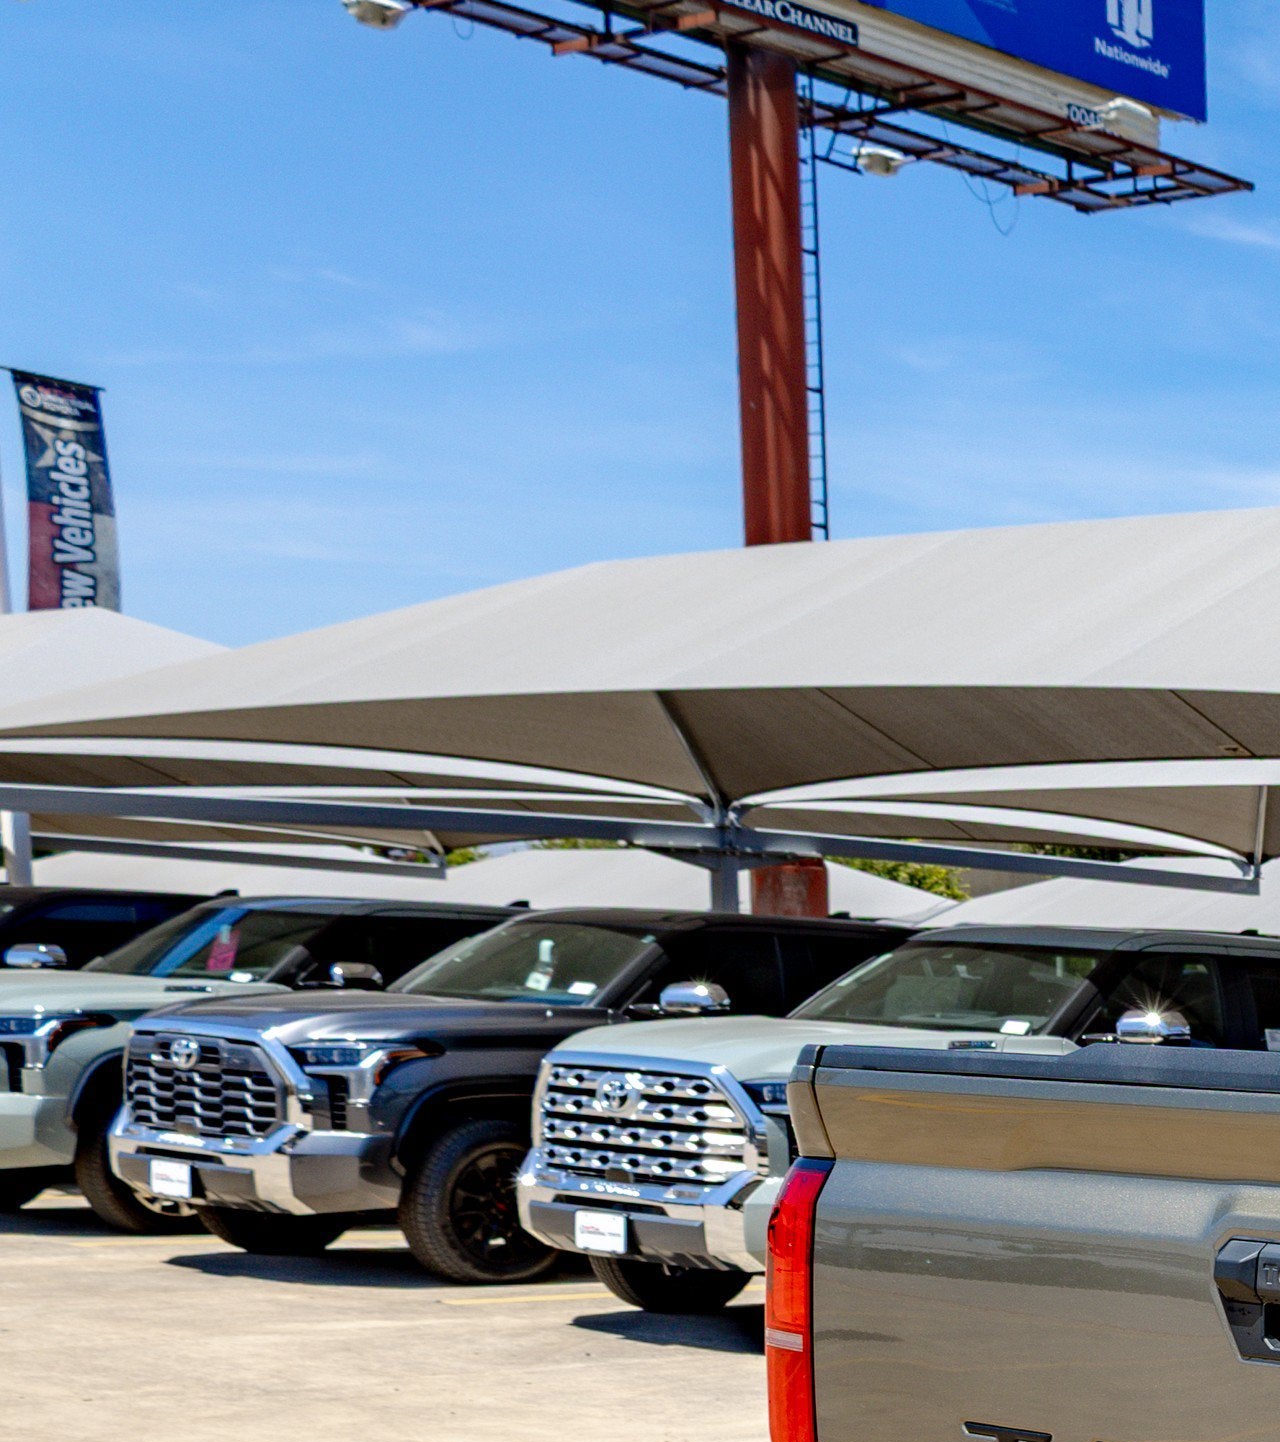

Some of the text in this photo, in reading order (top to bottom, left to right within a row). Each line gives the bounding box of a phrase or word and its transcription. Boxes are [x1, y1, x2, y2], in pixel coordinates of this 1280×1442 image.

[1093, 36, 1169, 80] Nationwide
[49, 438, 97, 564] Vehicles
[61, 567, 97, 609] ew
